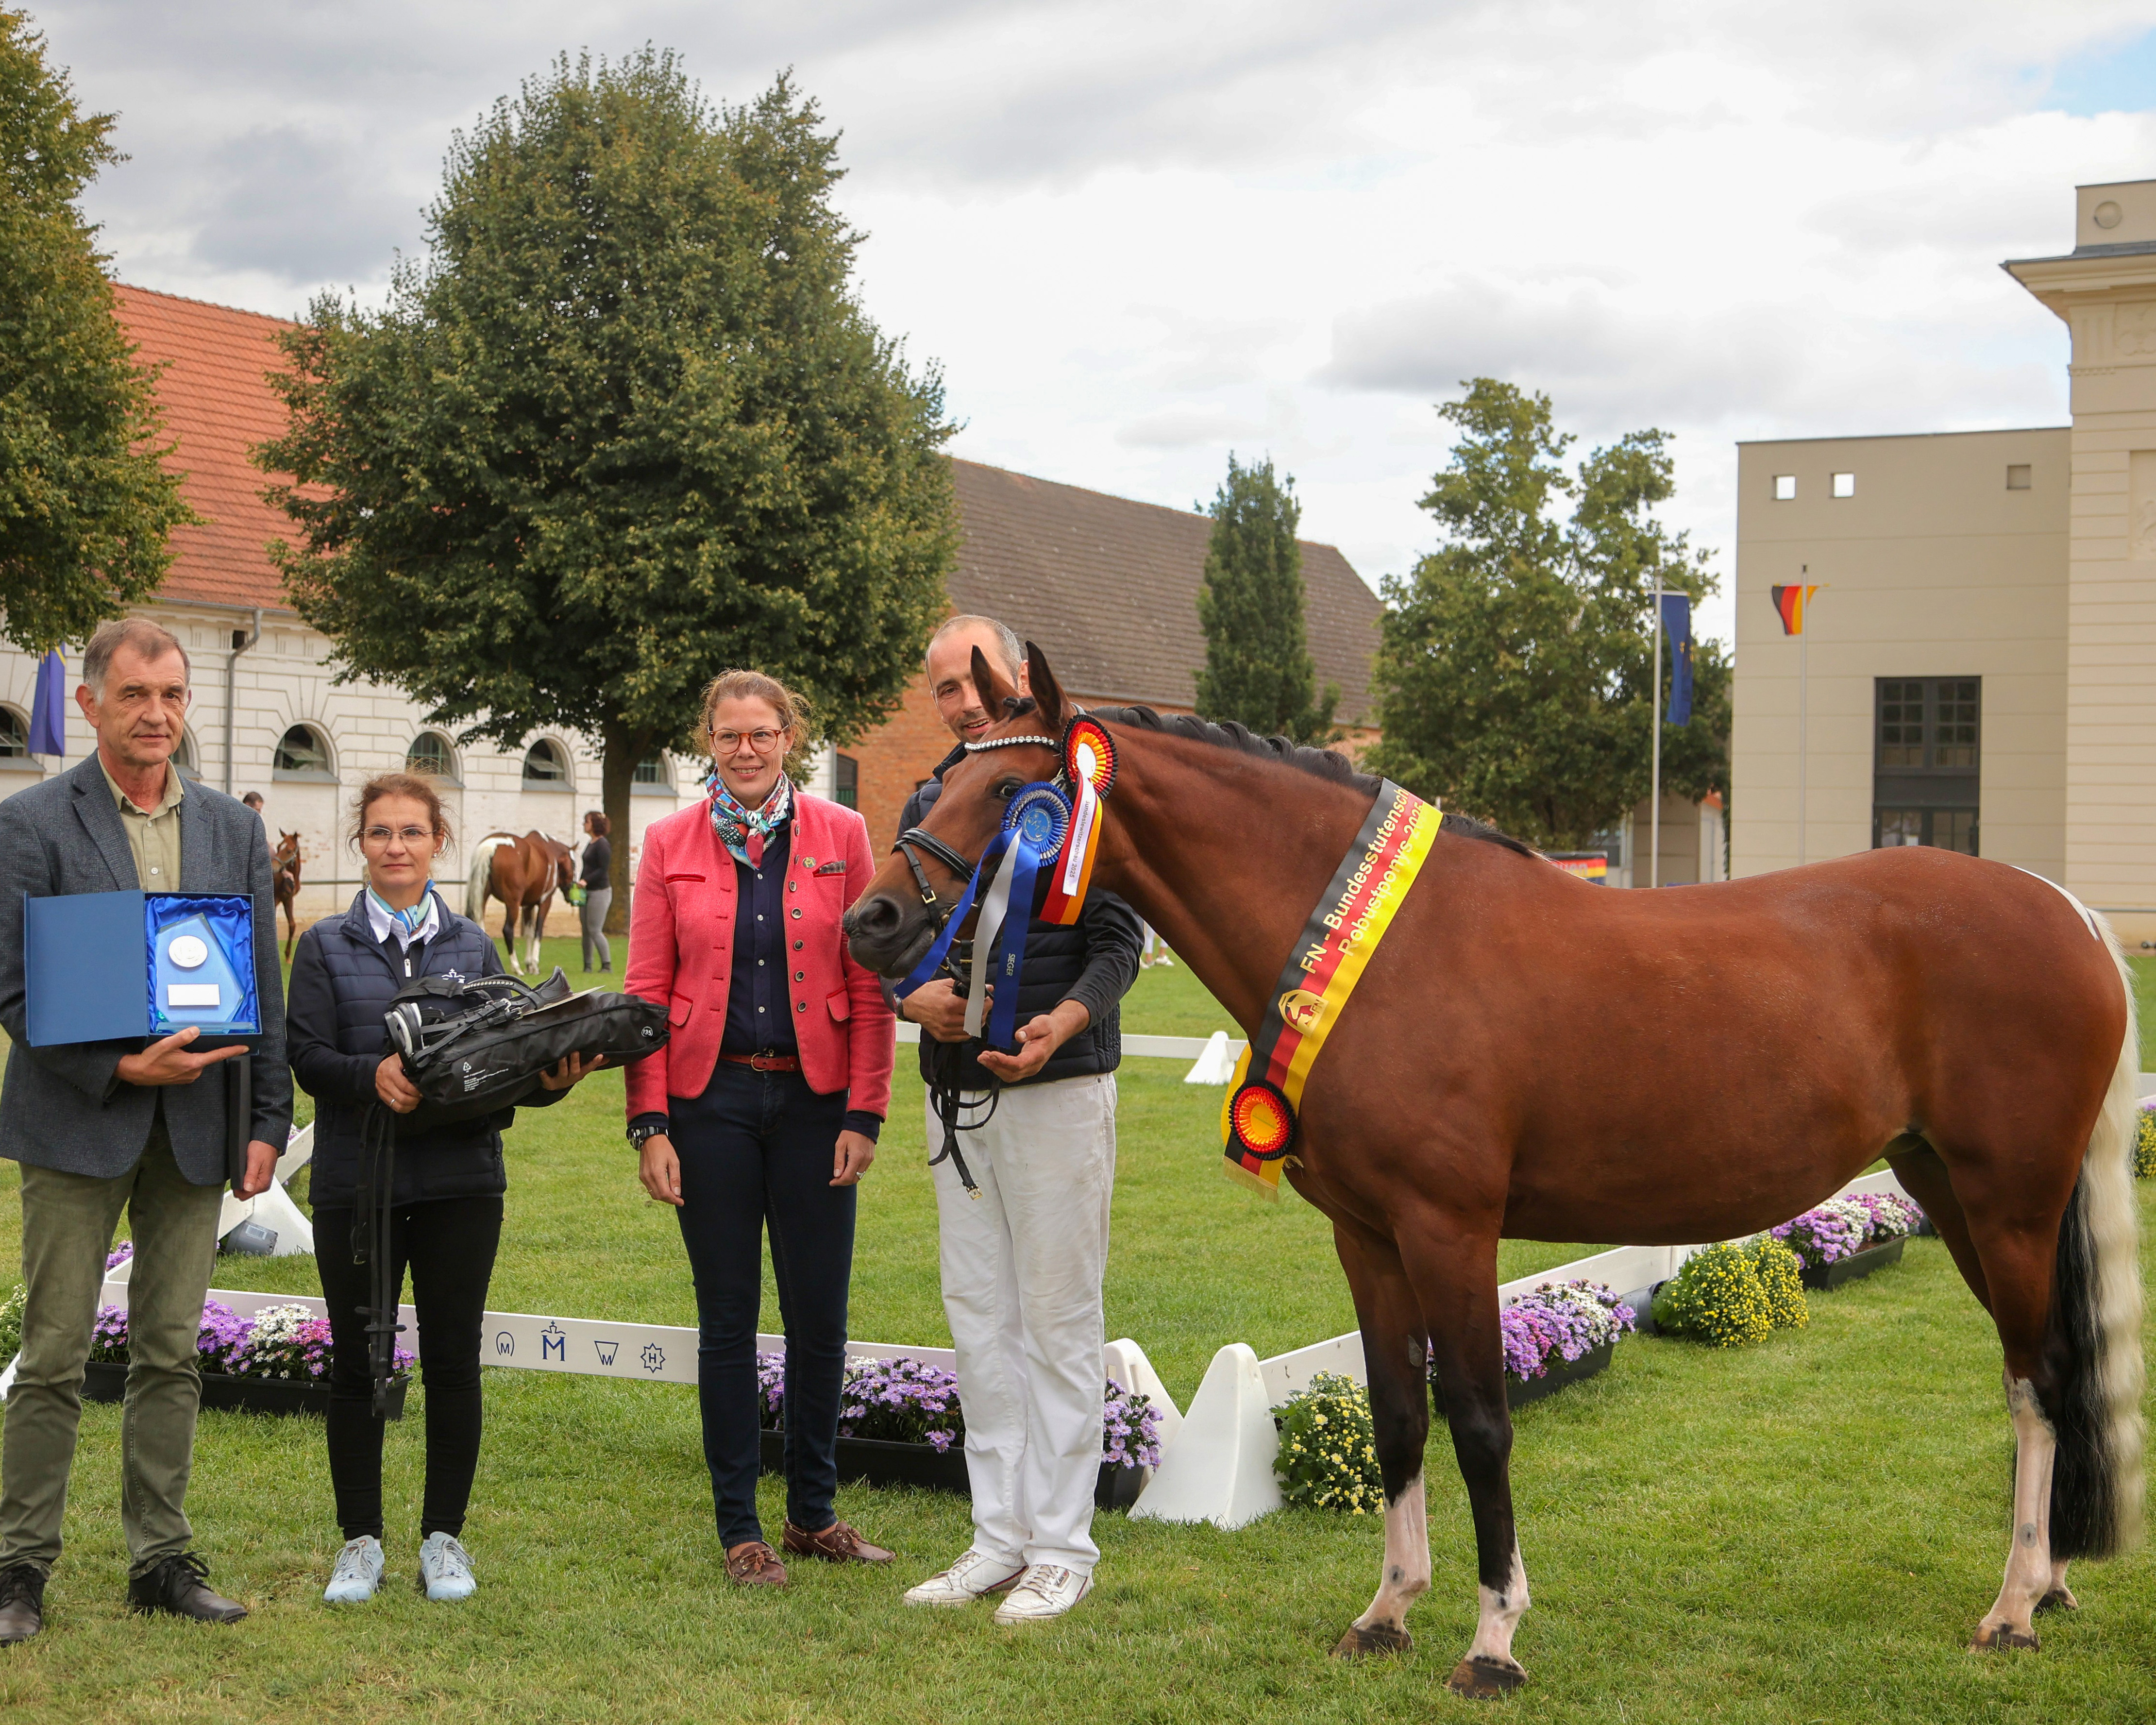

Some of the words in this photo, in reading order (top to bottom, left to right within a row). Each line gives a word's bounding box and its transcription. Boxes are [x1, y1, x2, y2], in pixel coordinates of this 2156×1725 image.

[1338, 840, 1414, 956] Robustponys
[1006, 953, 1016, 976] SIEGER
[1300, 944, 1327, 974] FN
[542, 1335, 566, 1362] M
[648, 1353, 657, 1364] H
